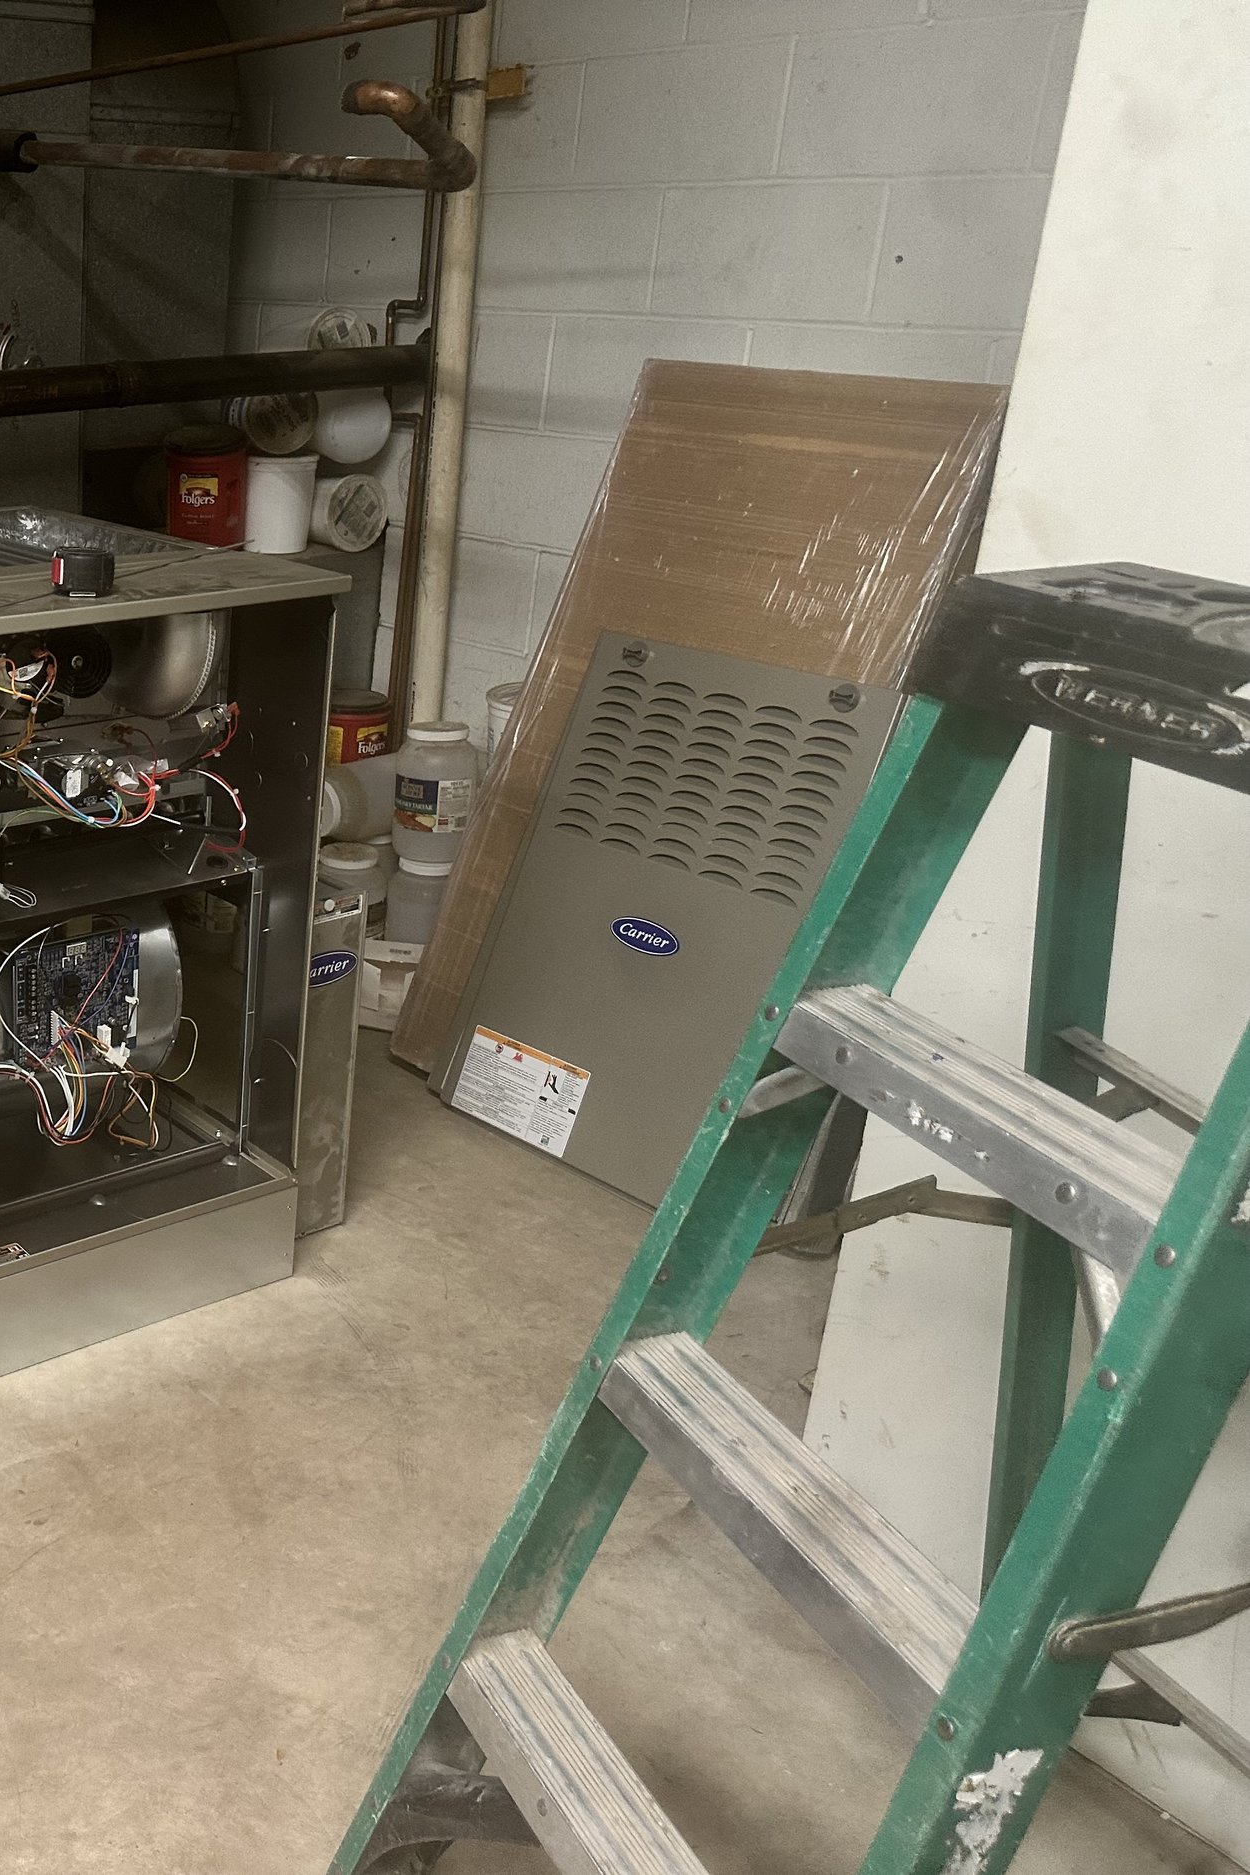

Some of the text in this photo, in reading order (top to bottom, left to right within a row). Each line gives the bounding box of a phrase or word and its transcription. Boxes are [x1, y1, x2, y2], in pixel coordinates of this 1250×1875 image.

[181, 491, 216, 508] Folgers
[619, 922, 670, 948] Carrier
[309, 959, 350, 978] arrier
